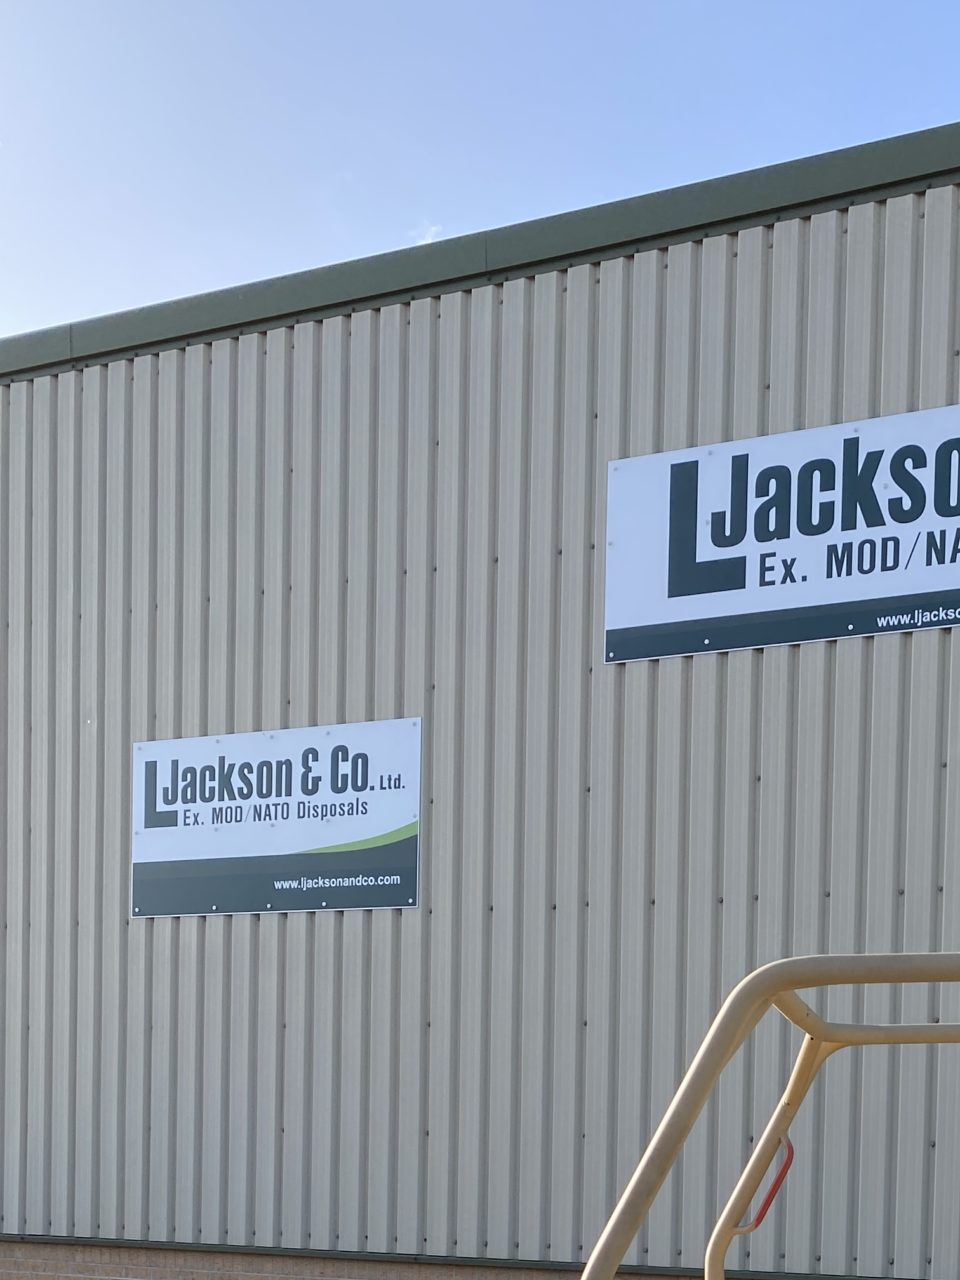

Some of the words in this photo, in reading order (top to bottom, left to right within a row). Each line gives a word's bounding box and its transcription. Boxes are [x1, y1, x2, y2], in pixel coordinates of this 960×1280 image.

[758, 551, 808, 588] Ex.
[300, 747, 322, 797] &
[330, 744, 375, 795] Co.
[379, 773, 405, 791] Ltd.
[183, 808, 205, 827] Ex.
[211, 801, 290, 825] MOD/NATO
[297, 797, 369, 822] Disposals
[273, 874, 401, 891] www.ljacksonandco.com
